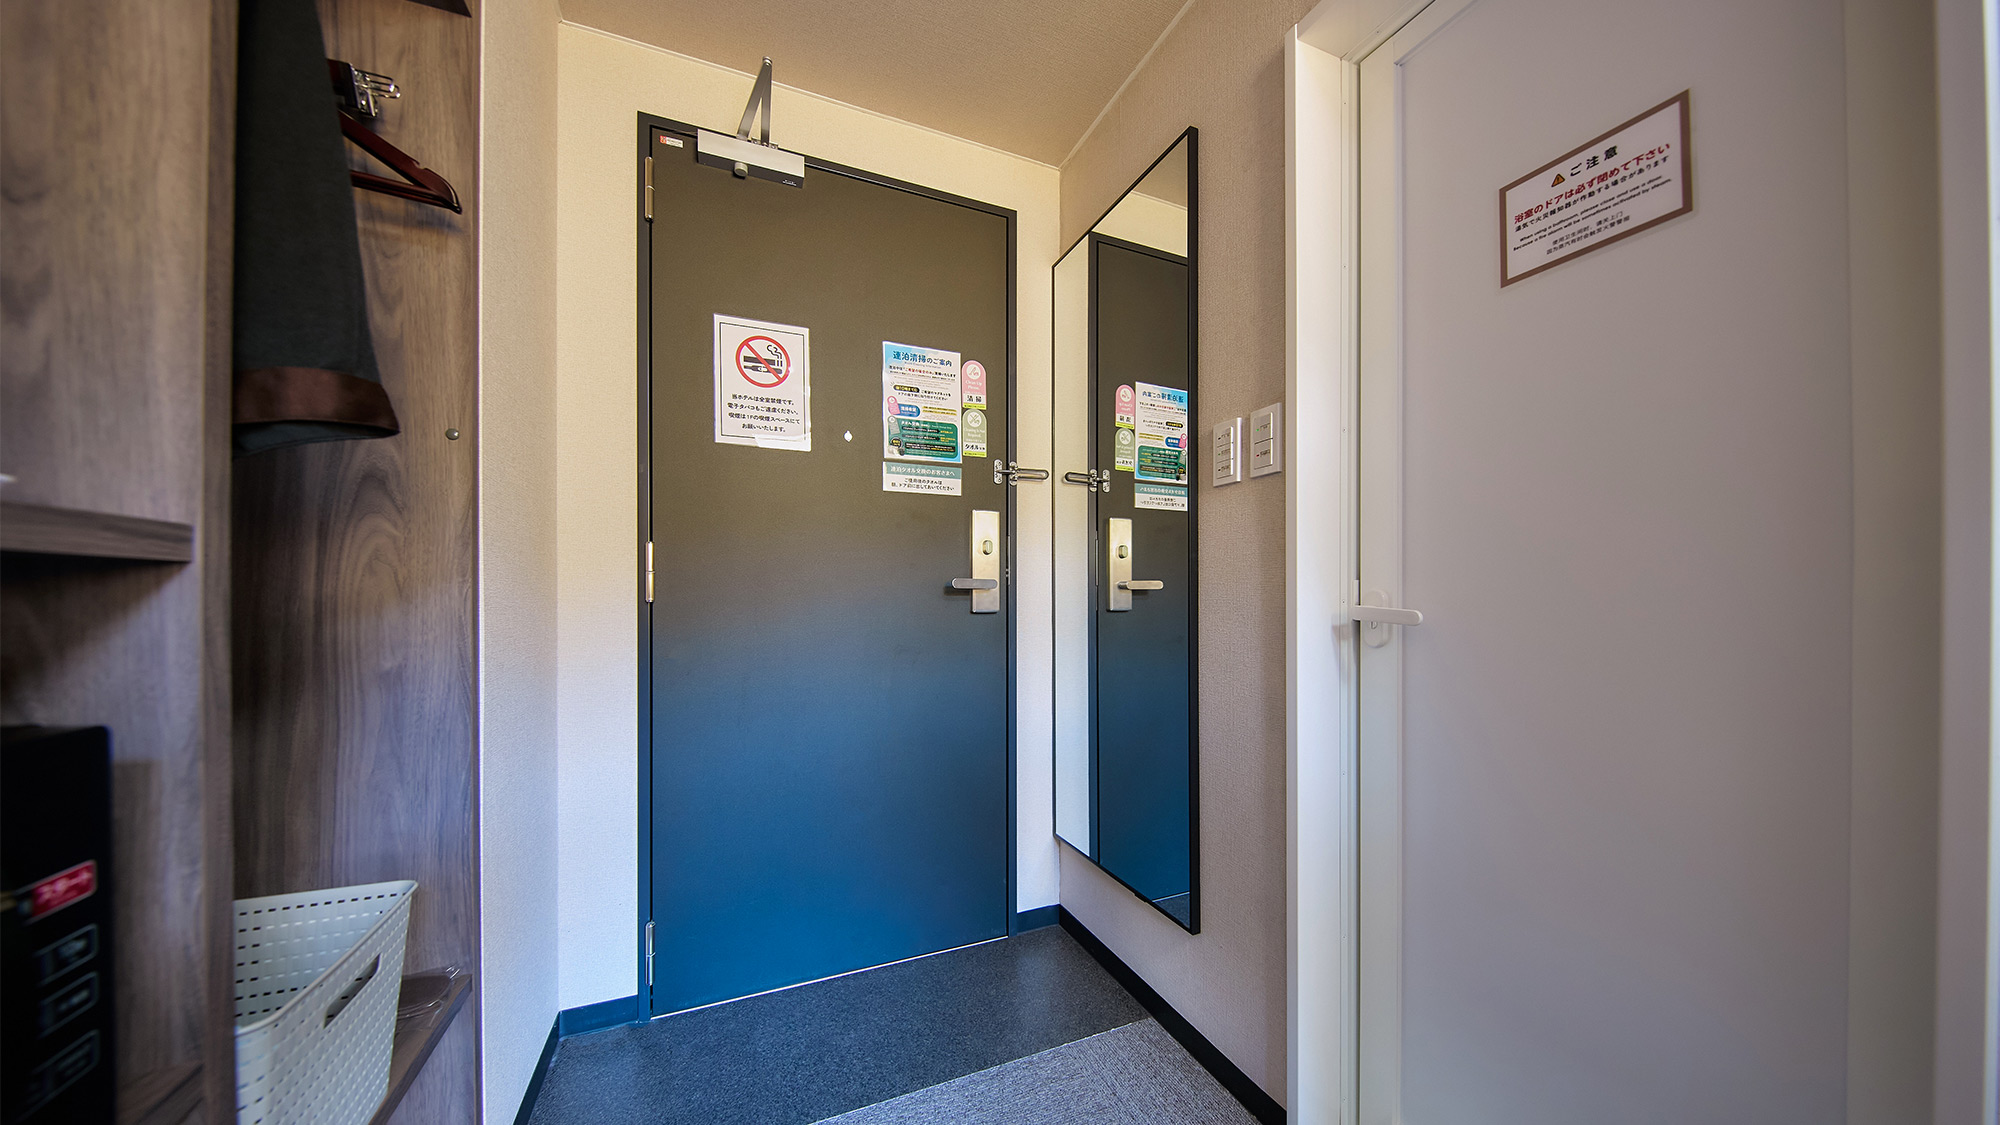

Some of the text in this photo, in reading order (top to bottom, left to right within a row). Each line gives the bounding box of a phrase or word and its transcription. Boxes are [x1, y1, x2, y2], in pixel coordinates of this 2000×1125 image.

[1570, 145, 1618, 176] ご注意
[1514, 143, 1670, 224] 浴室のドアは必ず閉めて下さい
[1513, 238, 1533, 251] Because
[1546, 226, 1562, 237] alarm
[1581, 204, 1611, 221] sometimes
[1612, 191, 1640, 207] activated
[1642, 186, 1649, 195] by
[1520, 232, 1533, 242] When
[1534, 226, 1546, 236] using
[1580, 202, 1598, 215] please
[1600, 195, 1614, 206] close
[1616, 189, 1627, 198] and
[1629, 184, 1640, 192] use
[893, 351, 952, 367] 連泊清掃のご案内
[727, 403, 798, 415] 電子タバコもご遠慮ください。
[732, 394, 794, 405] 当ホテルは全室禁煙です。
[742, 423, 786, 432] お願いいたします。
